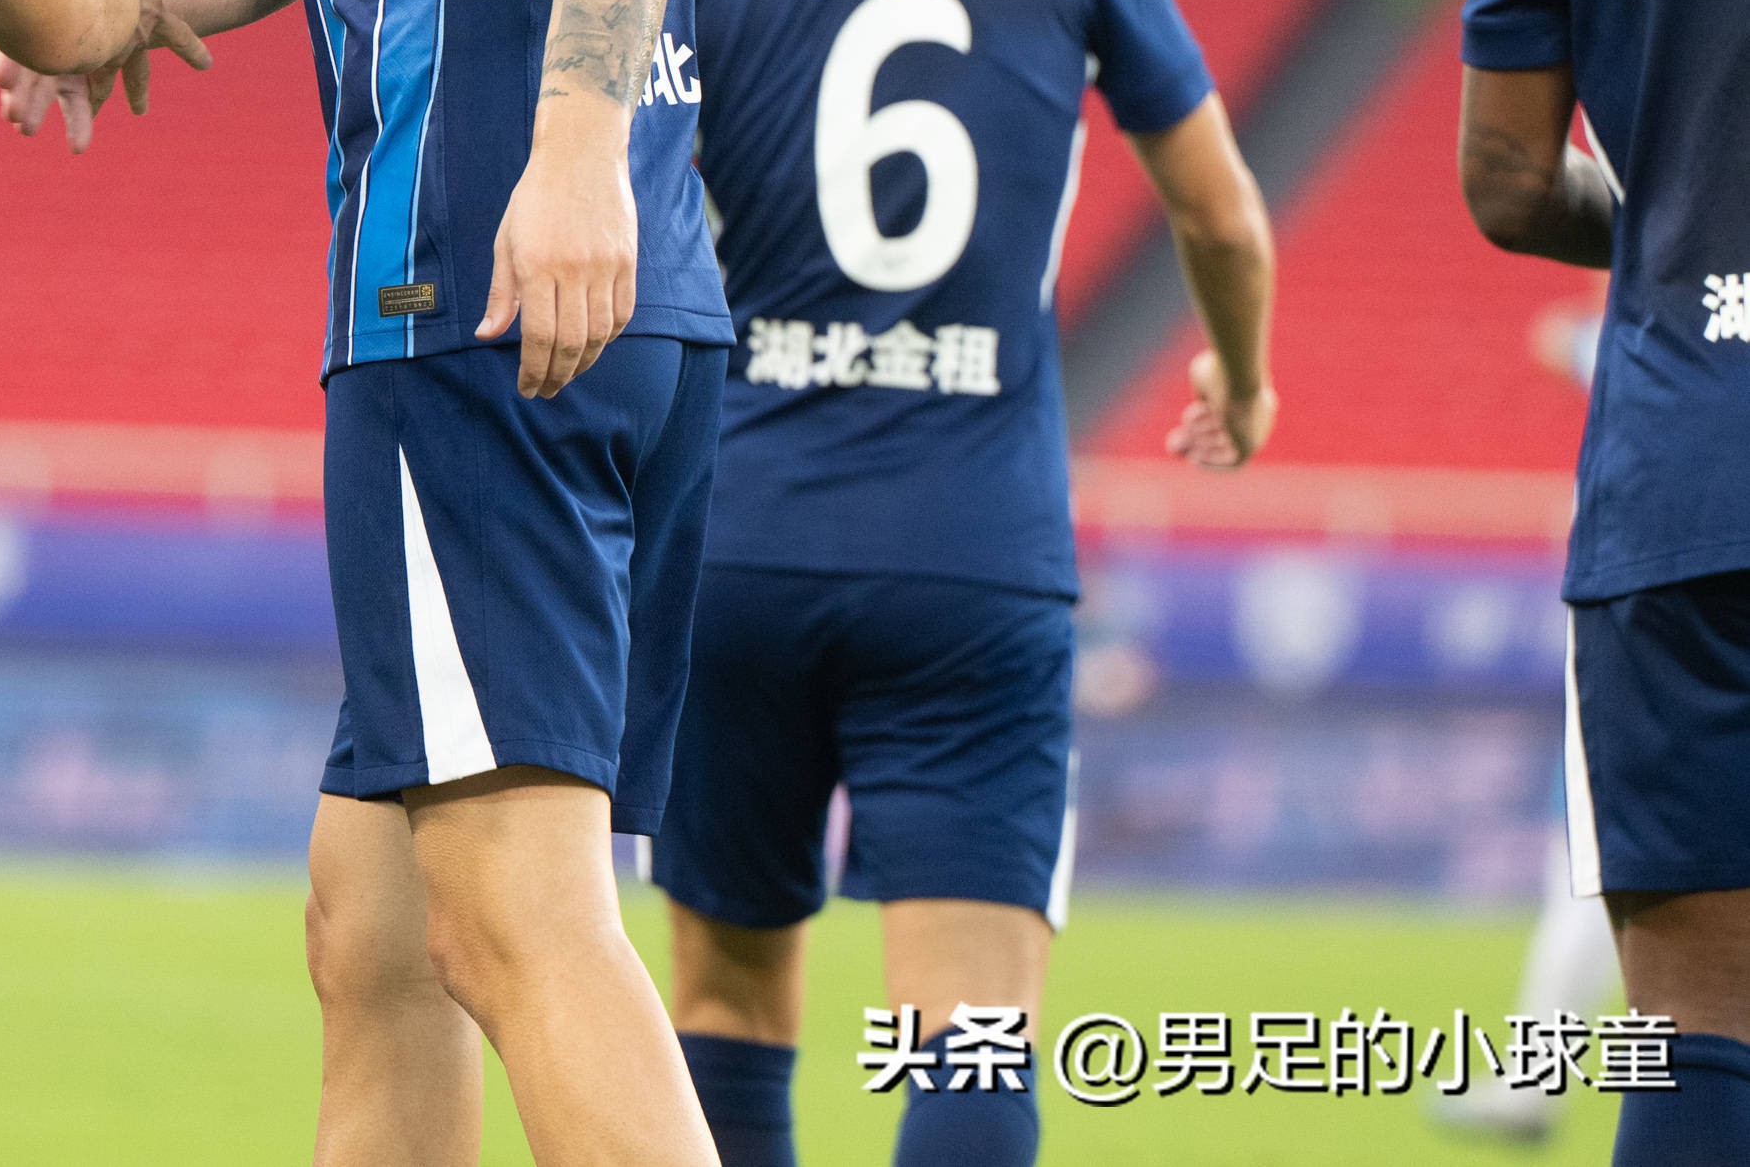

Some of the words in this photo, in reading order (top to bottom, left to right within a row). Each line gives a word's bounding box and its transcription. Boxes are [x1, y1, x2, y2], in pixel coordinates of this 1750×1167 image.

[638, 33, 702, 106] 北
[746, 318, 1002, 396] 湖北金租
